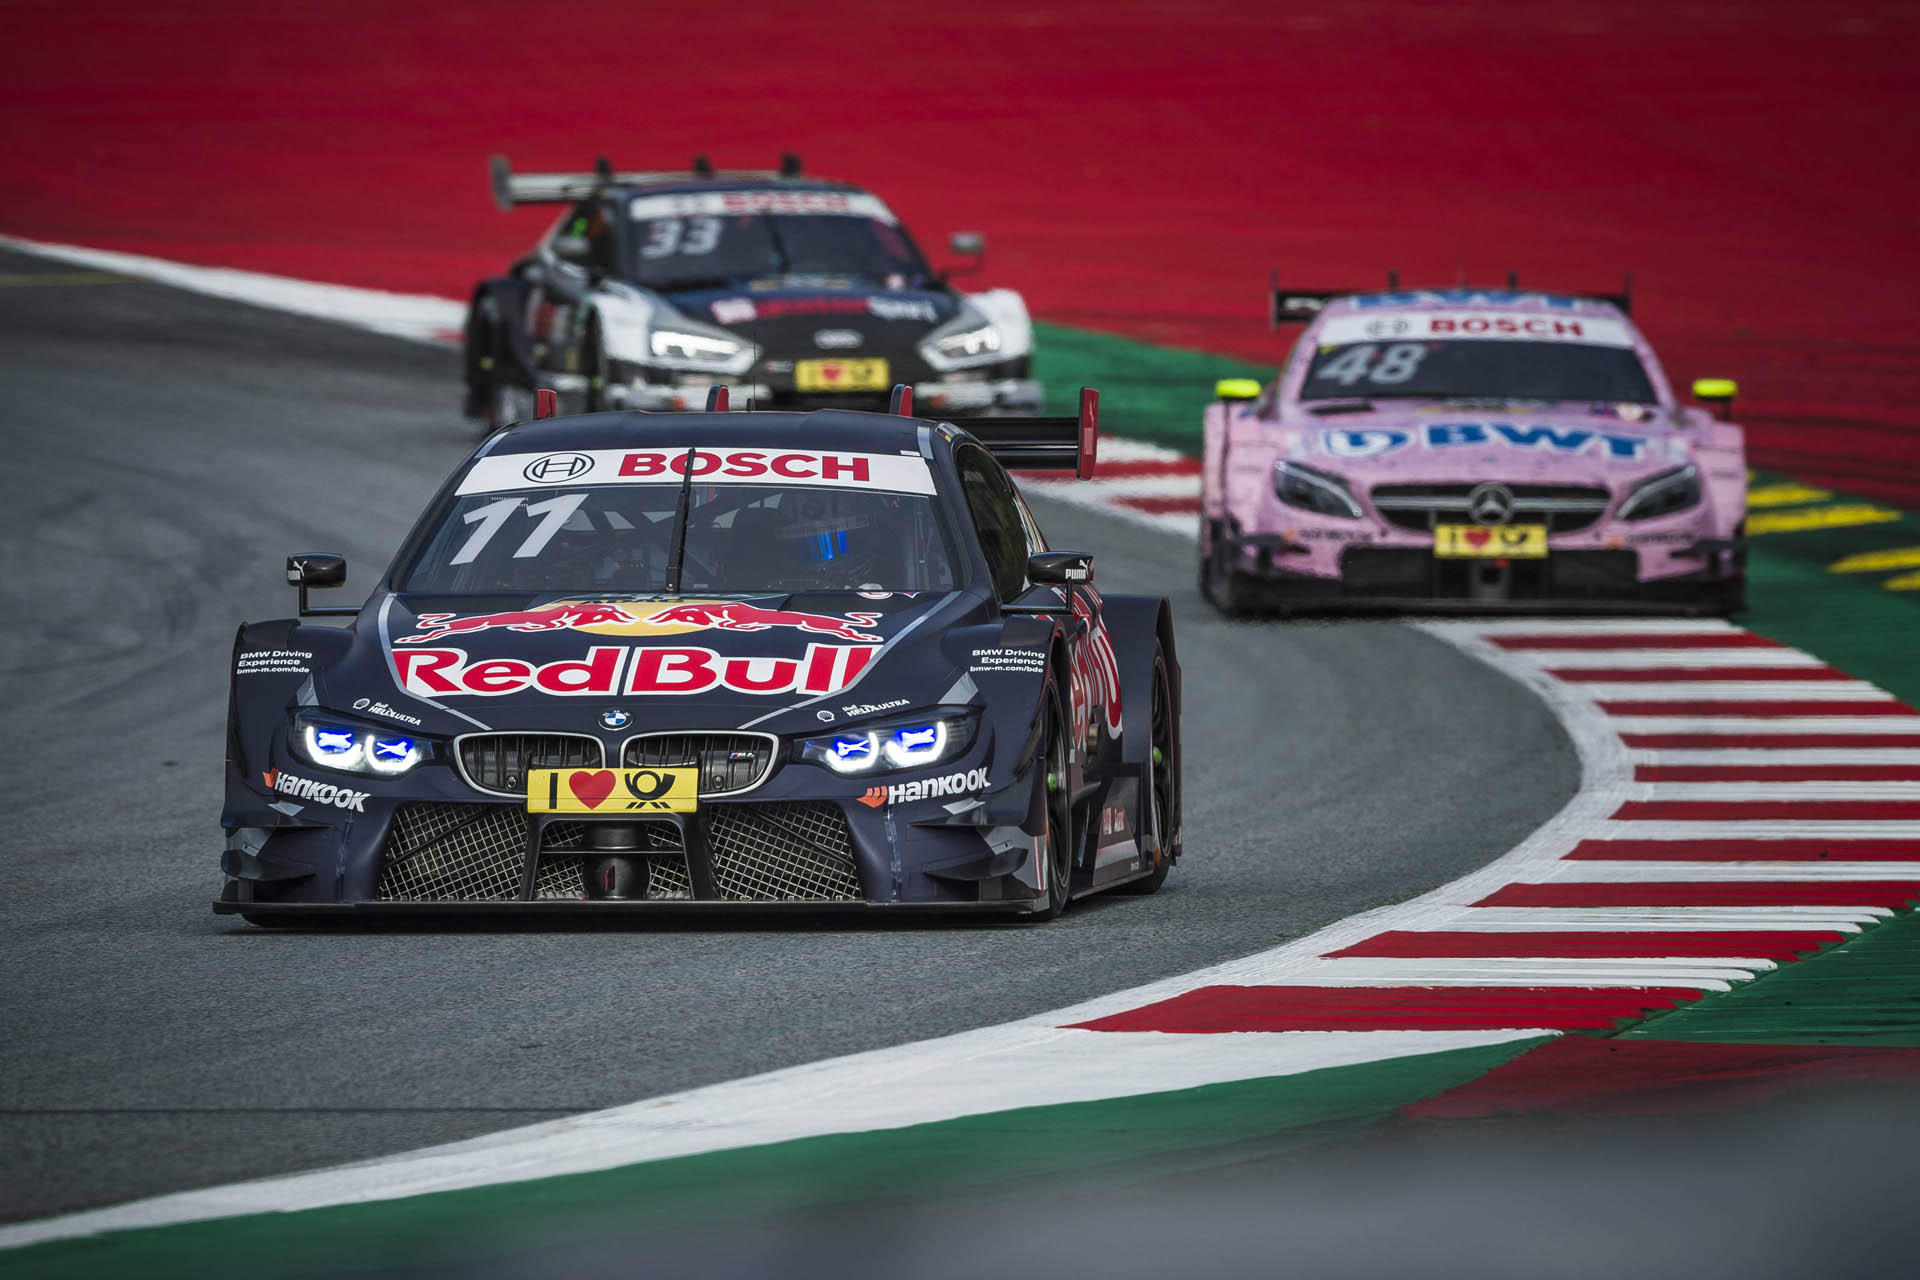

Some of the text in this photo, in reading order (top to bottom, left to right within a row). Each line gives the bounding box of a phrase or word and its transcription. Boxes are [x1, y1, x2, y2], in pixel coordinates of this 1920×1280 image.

[641, 216, 722, 258] 33
[1429, 318, 1584, 337] BOSCH
[1316, 343, 1431, 386] 48
[1424, 423, 1650, 458] BWT
[617, 452, 870, 482] BOSCH
[449, 493, 590, 566] 11
[1065, 568, 1087, 580] PUMA
[240, 650, 313, 660] BMW Driving
[972, 648, 1046, 659] BMW Driving
[981, 656, 1045, 665] Experience
[236, 666, 310, 675] bmw-m.com/bde
[238, 658, 301, 667] Experience
[391, 645, 625, 696] Red
[623, 643, 884, 696] Bull
[969, 665, 1044, 673] bmw-m.com/bde
[877, 699, 911, 711] ULTRA
[394, 712, 422, 726] ULTRA
[549, 772, 559, 810] I
